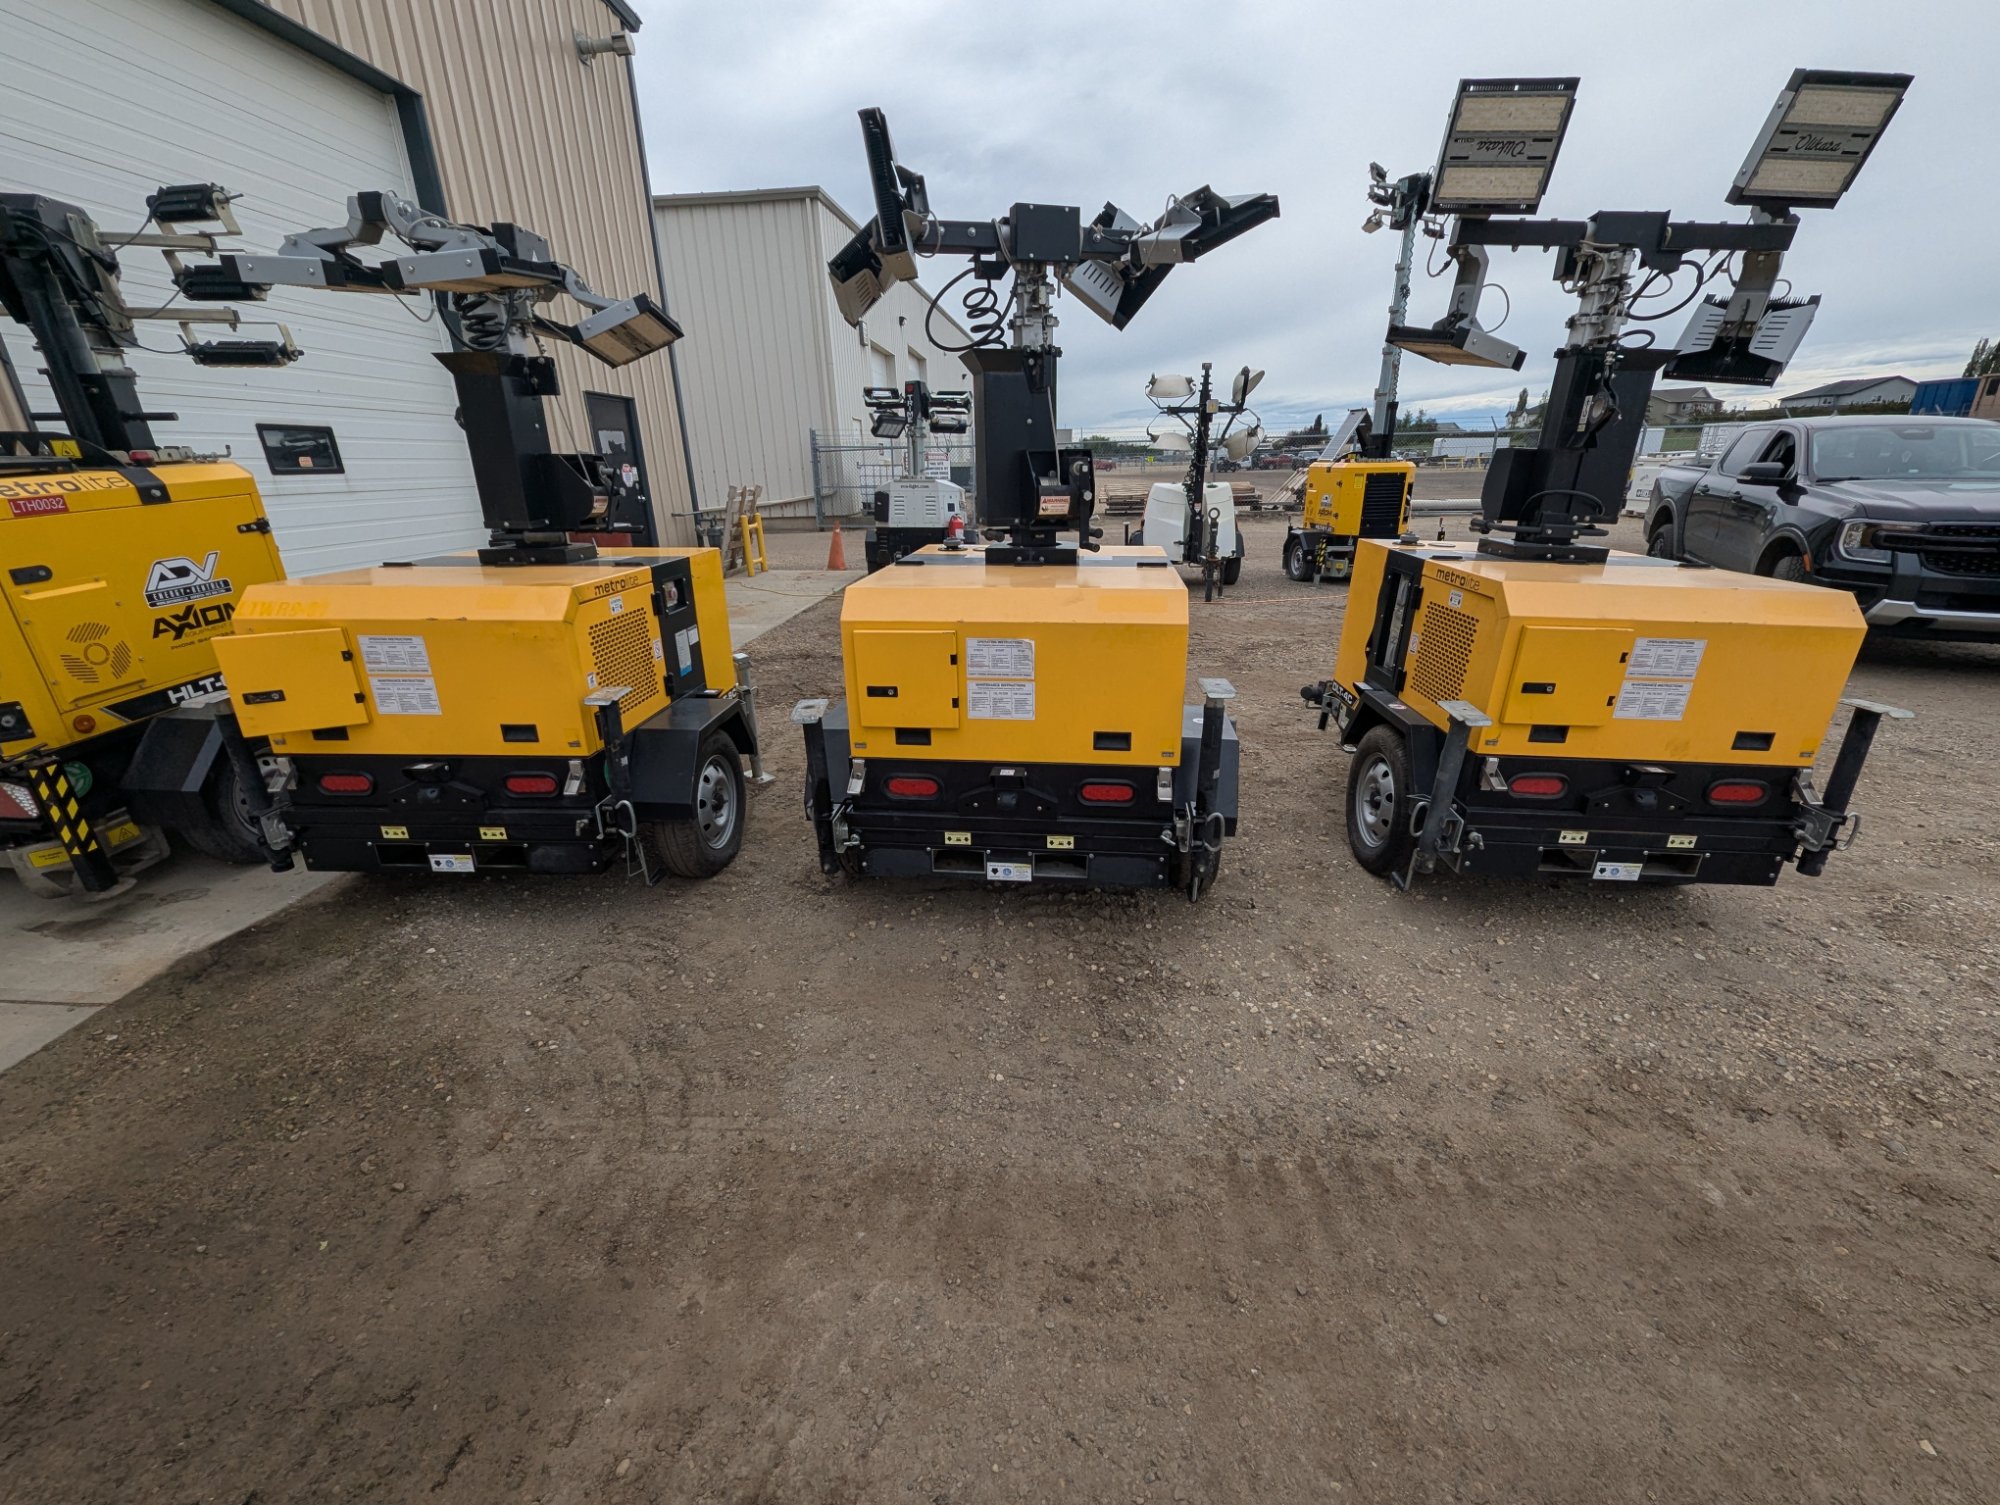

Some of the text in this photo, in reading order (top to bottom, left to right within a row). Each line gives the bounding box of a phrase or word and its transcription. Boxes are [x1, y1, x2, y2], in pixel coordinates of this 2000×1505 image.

[10, 497, 66, 514] LTH0032
[594, 575, 639, 597] metrolite
[1436, 568, 1481, 591] metrolite
